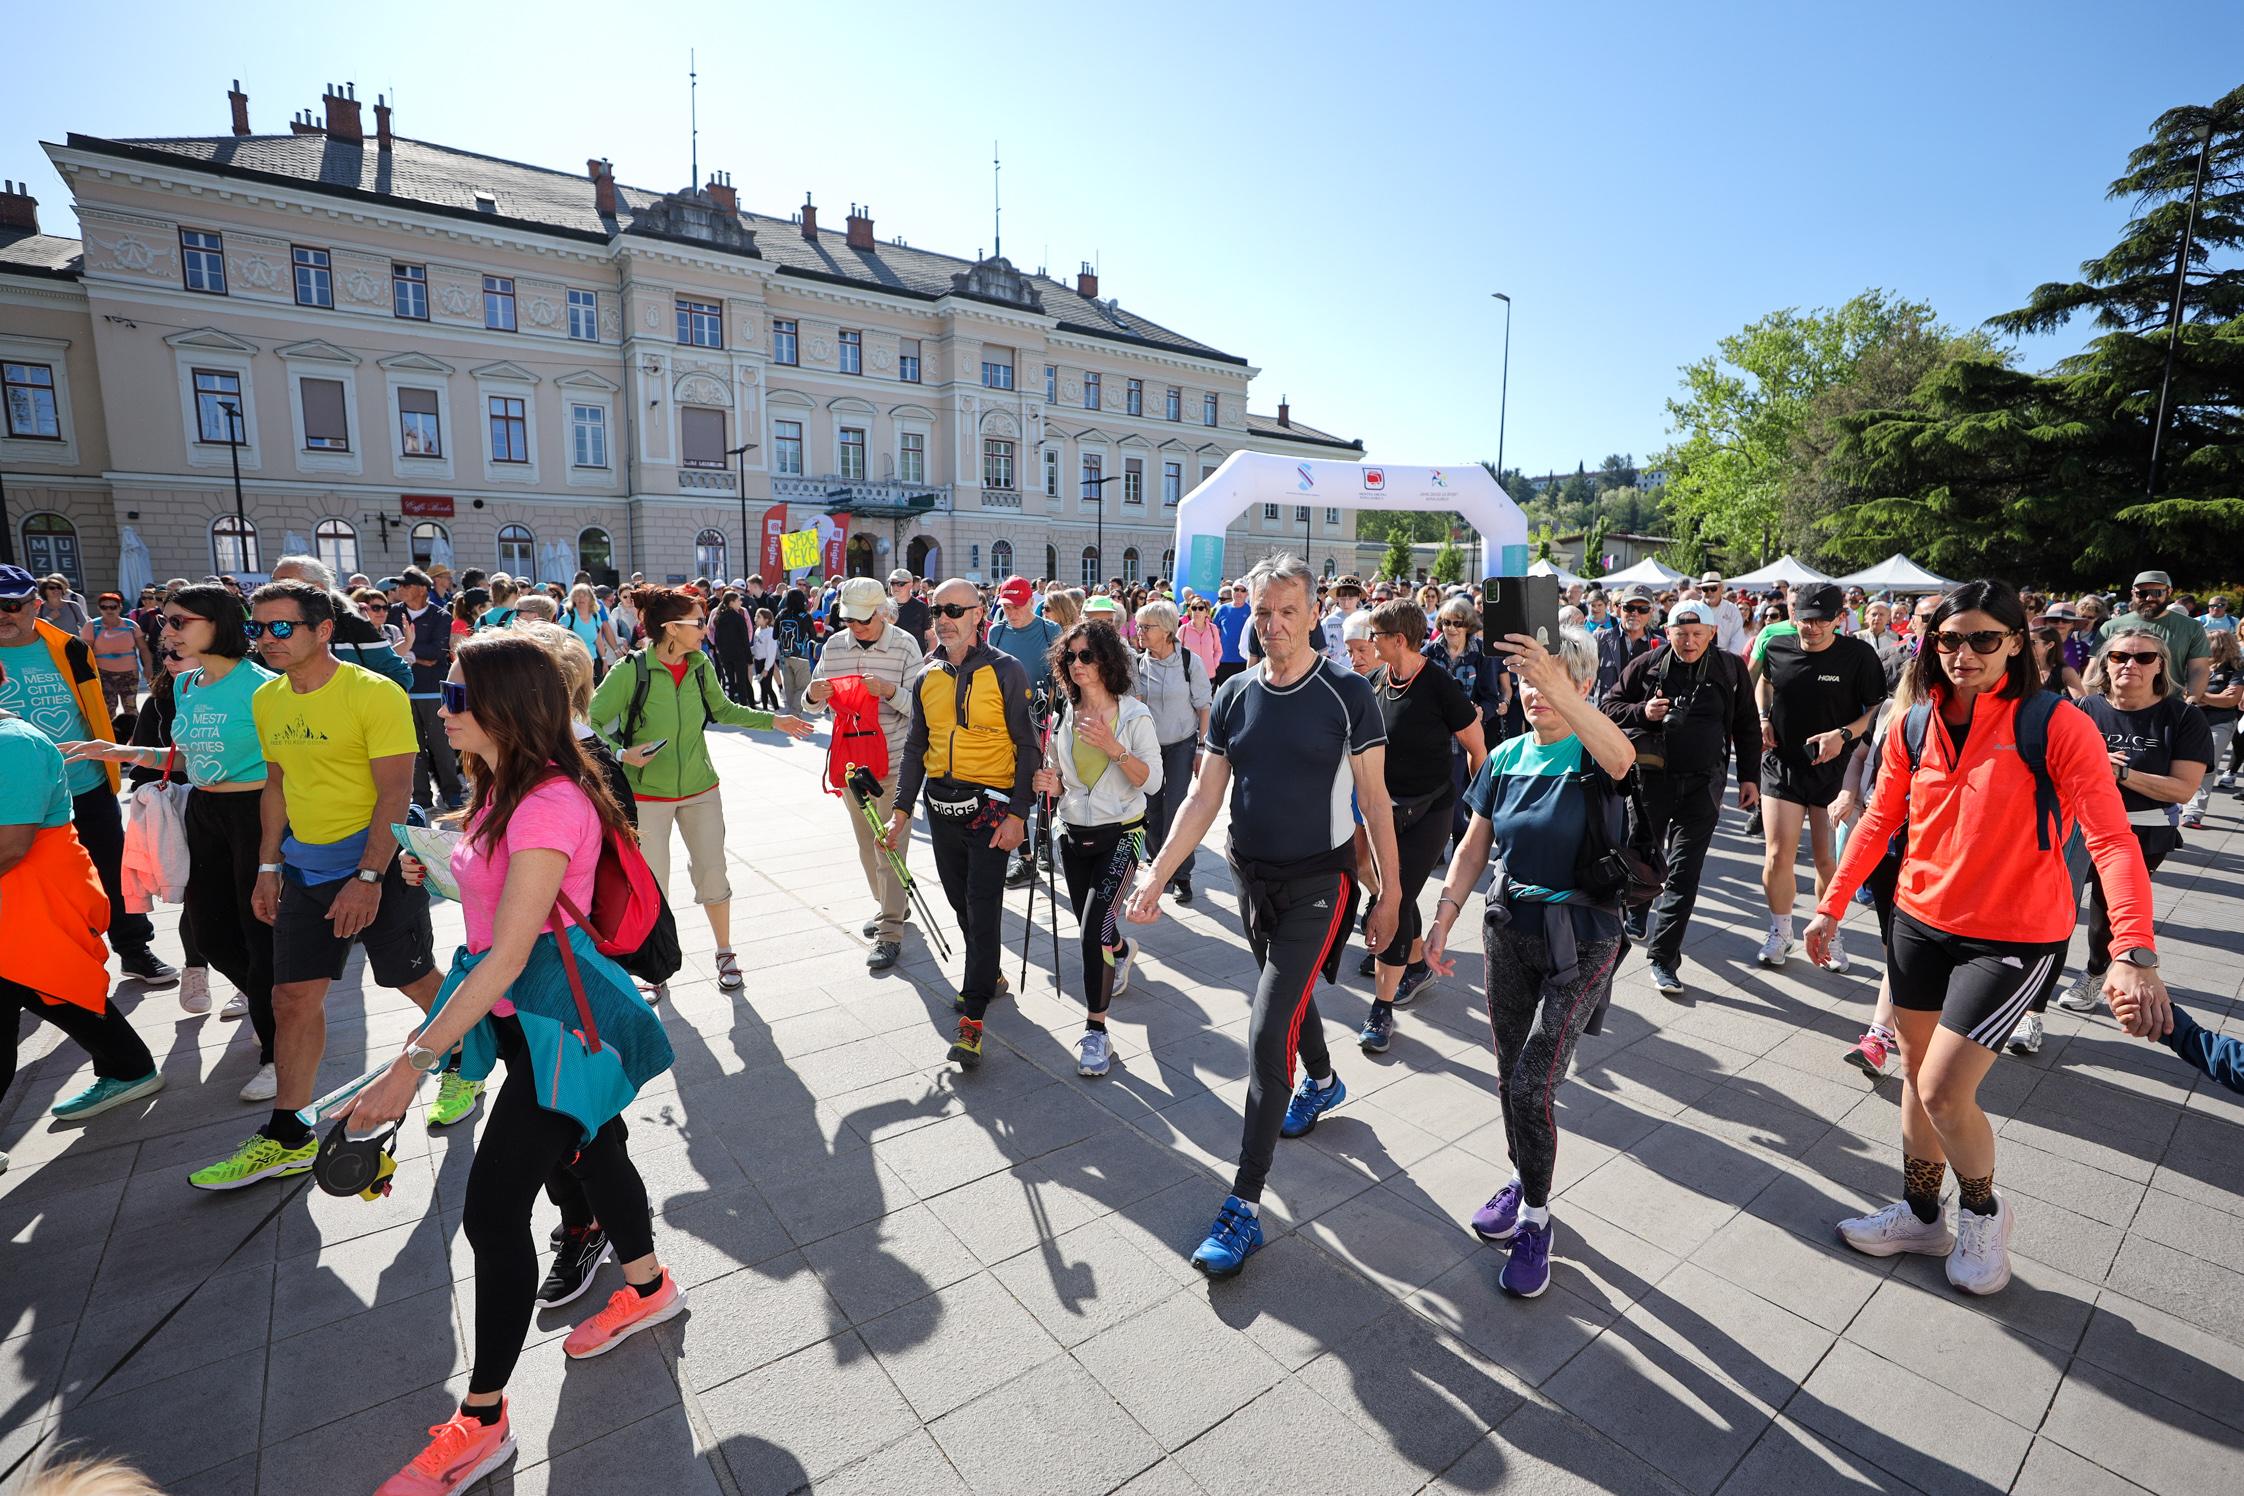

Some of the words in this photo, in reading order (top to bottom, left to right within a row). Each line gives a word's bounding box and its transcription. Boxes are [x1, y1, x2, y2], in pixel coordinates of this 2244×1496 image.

[767, 536, 778, 566] triglav
[831, 542, 840, 569] triglav
[1817, 674, 1840, 682] HOKA
[31, 694, 72, 706] CITIES
[192, 713, 228, 725] MESTI
[190, 741, 225, 753] CITIES
[931, 803, 976, 817] didas
